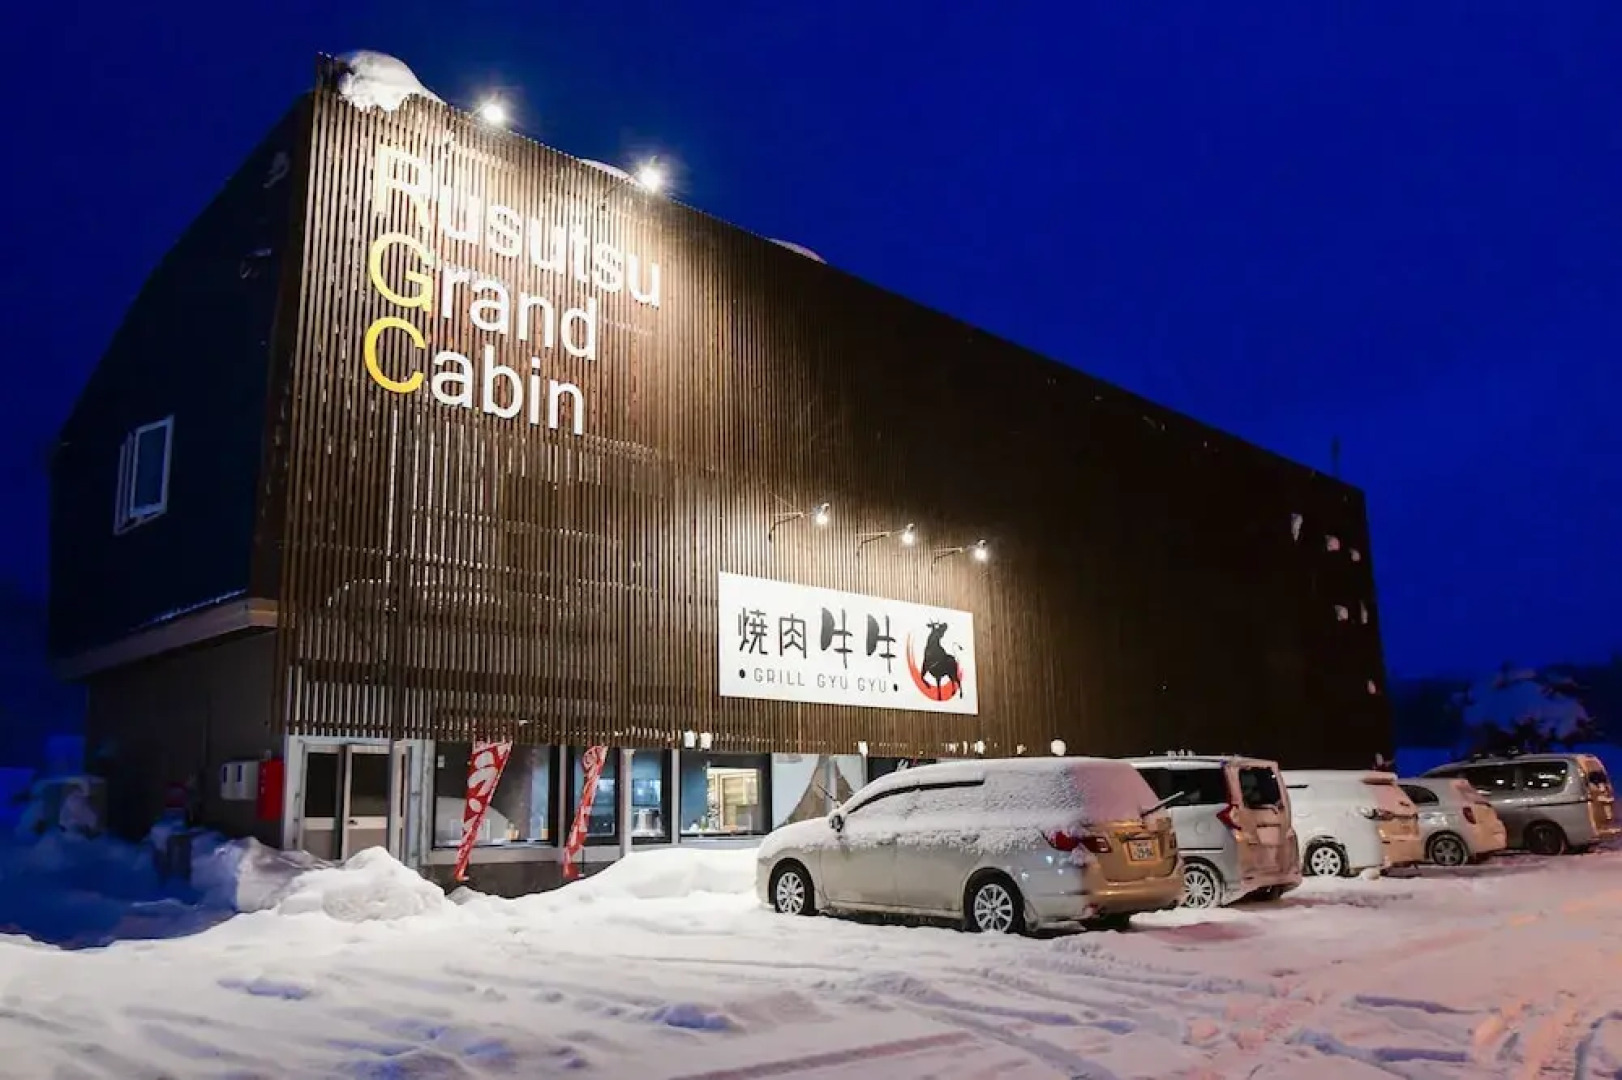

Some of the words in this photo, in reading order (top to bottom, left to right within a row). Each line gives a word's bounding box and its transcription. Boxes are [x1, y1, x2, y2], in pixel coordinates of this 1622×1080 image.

[373, 145, 660, 308] Rusutsu
[369, 231, 597, 361] Grand
[364, 316, 583, 435] Cabin
[753, 667, 805, 686] GRILL
[817, 673, 848, 690] GYU
[857, 677, 887, 693] GYU
